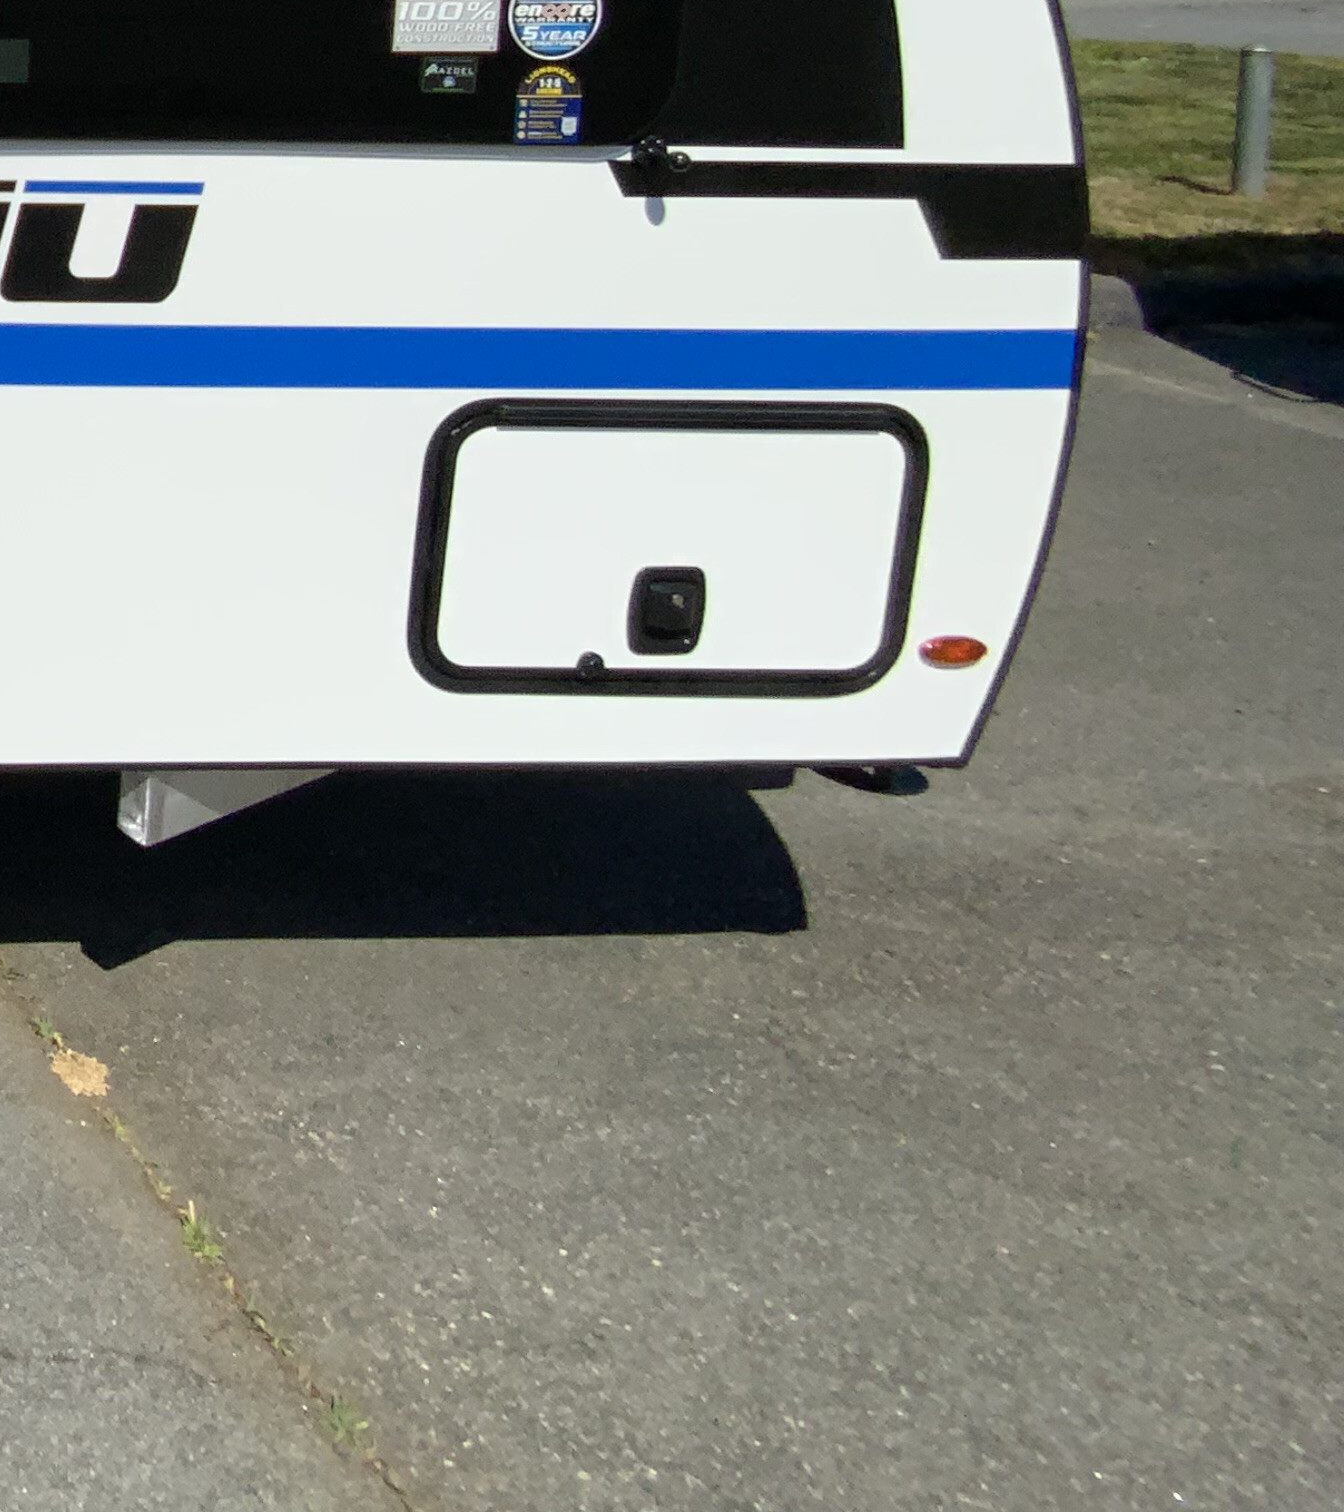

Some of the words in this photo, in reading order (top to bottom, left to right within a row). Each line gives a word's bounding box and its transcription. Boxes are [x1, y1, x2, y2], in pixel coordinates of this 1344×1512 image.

[398, 1, 496, 21] 100%
[399, 22, 450, 32] WOOD
[454, 22, 496, 32] FREE
